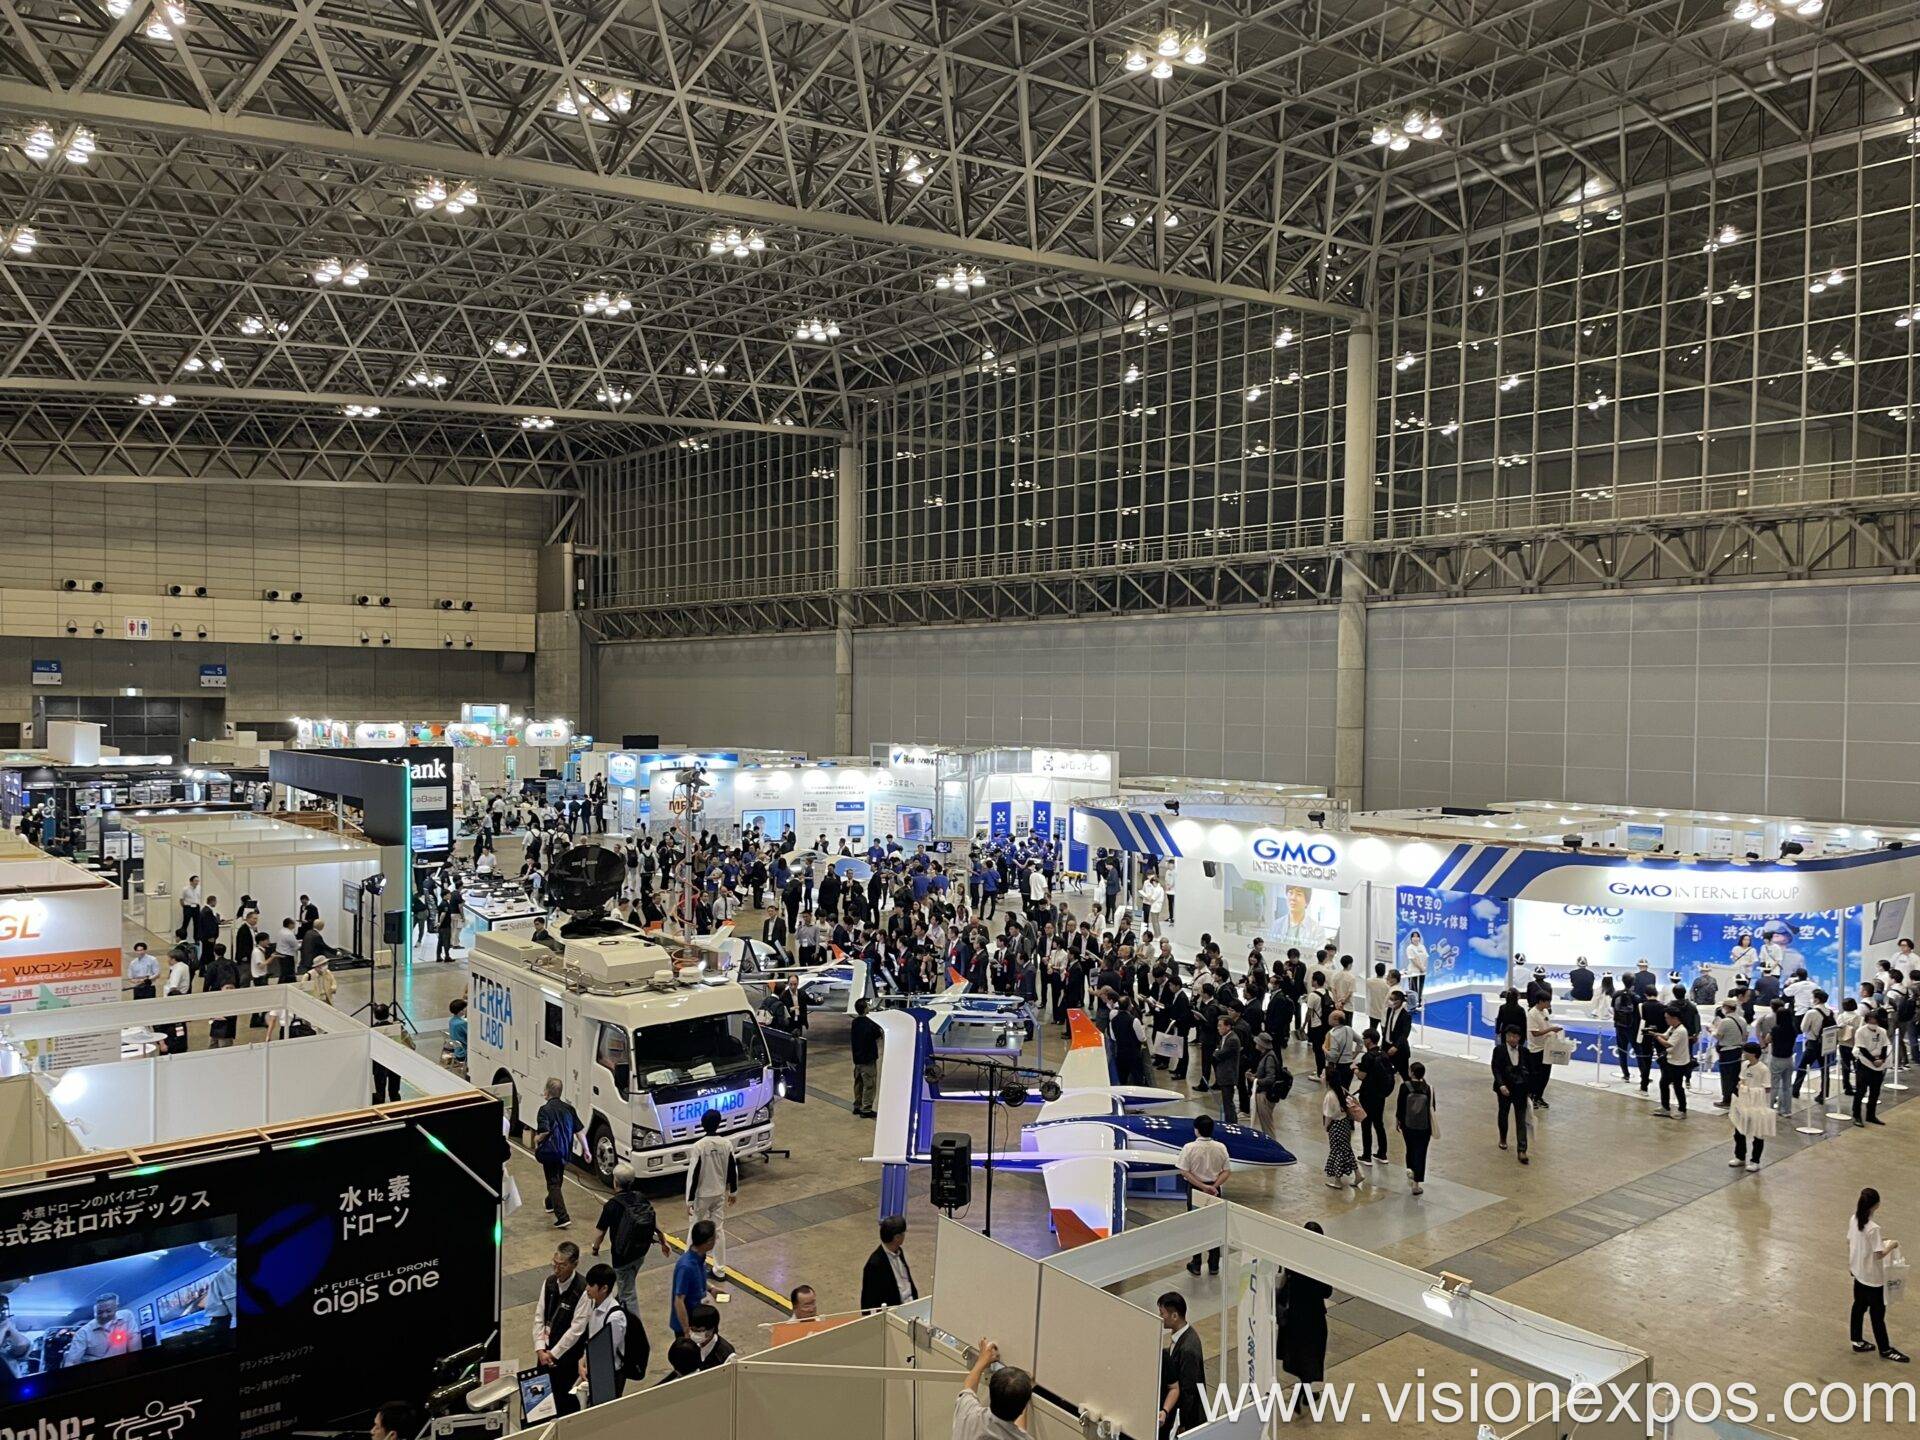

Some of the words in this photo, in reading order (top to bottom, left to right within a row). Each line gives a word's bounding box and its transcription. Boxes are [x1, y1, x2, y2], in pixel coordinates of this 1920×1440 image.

[51, 663, 58, 672] 5
[217, 667, 224, 675] 5
[365, 728, 397, 739] WRS
[535, 728, 561, 738] WRS
[1253, 838, 1337, 867] GMO
[1252, 860, 1299, 877] INTERNET
[1300, 865, 1337, 881] GROUP
[1400, 892, 1442, 911] VRで空の
[1609, 882, 1672, 898] GMO
[1675, 886, 1749, 900] INTERNET
[1751, 887, 1800, 900] GROUP
[1400, 908, 1468, 930] セキュリティ体験
[13, 958, 113, 976] VUXコンソーシアム
[471, 971, 512, 1027] TERRA
[480, 1013, 504, 1050] LABO
[670, 1100, 709, 1122] TERRA
[714, 1092, 744, 1113] LABO
[22, 1185, 159, 1221] 水素ドローンのパイオニア
[339, 1186, 363, 1213] 水
[388, 1175, 410, 1202] 素
[343, 1205, 410, 1241] ドローン
[331, 1277, 362, 1291] FUEL
[365, 1269, 394, 1282] CELL
[396, 1258, 440, 1275] DRONE
[313, 1283, 380, 1316] aigis
[388, 1270, 440, 1297] one
